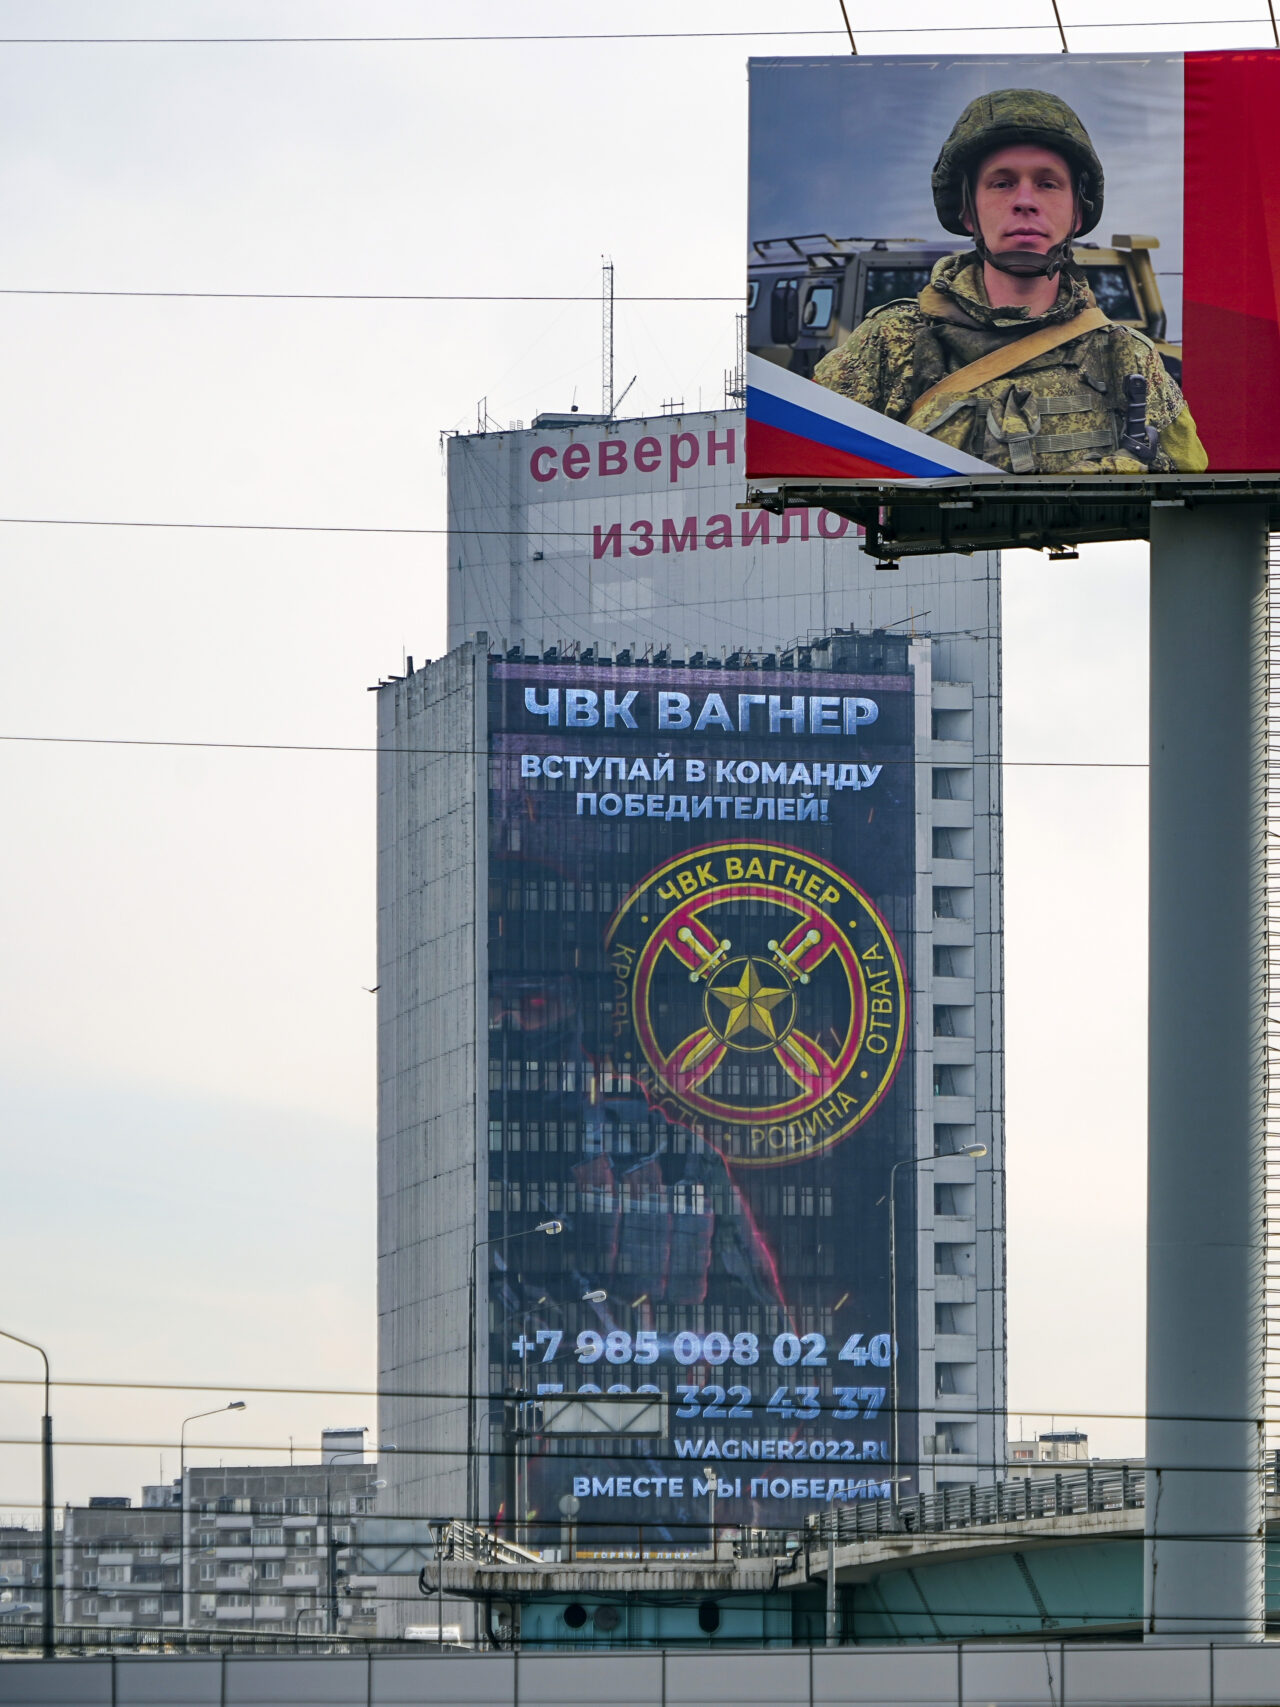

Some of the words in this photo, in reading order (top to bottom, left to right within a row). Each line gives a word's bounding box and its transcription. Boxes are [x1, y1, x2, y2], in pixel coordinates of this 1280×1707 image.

[529, 428, 746, 482] северн
[524, 687, 639, 729] ЧВК
[658, 691, 879, 735] ВАГНЕР
[521, 753, 676, 782] ВСТУПАЙ
[686, 760, 705, 782] В
[715, 760, 883, 791] КОМАНДУ
[576, 792, 829, 822] ПОБЕДИТЕЛЕЙ!
[657, 861, 720, 901] ЧВК
[725, 857, 841, 905] ВАГНЕР
[861, 942, 893, 1054] ОТВАГА
[751, 1090, 858, 1151] РОДИНА
[511, 1330, 564, 1362] +7
[576, 1330, 660, 1365] 985
[673, 1331, 760, 1366] 008
[772, 1333, 828, 1367] 02
[838, 1333, 898, 1367] 40
[675, 1385, 753, 1419] 322
[766, 1386, 821, 1420] 43
[832, 1387, 886, 1420] 37
[573, 1476, 684, 1498] ВМЕСТЕ
[692, 1478, 741, 1498] МЫ
